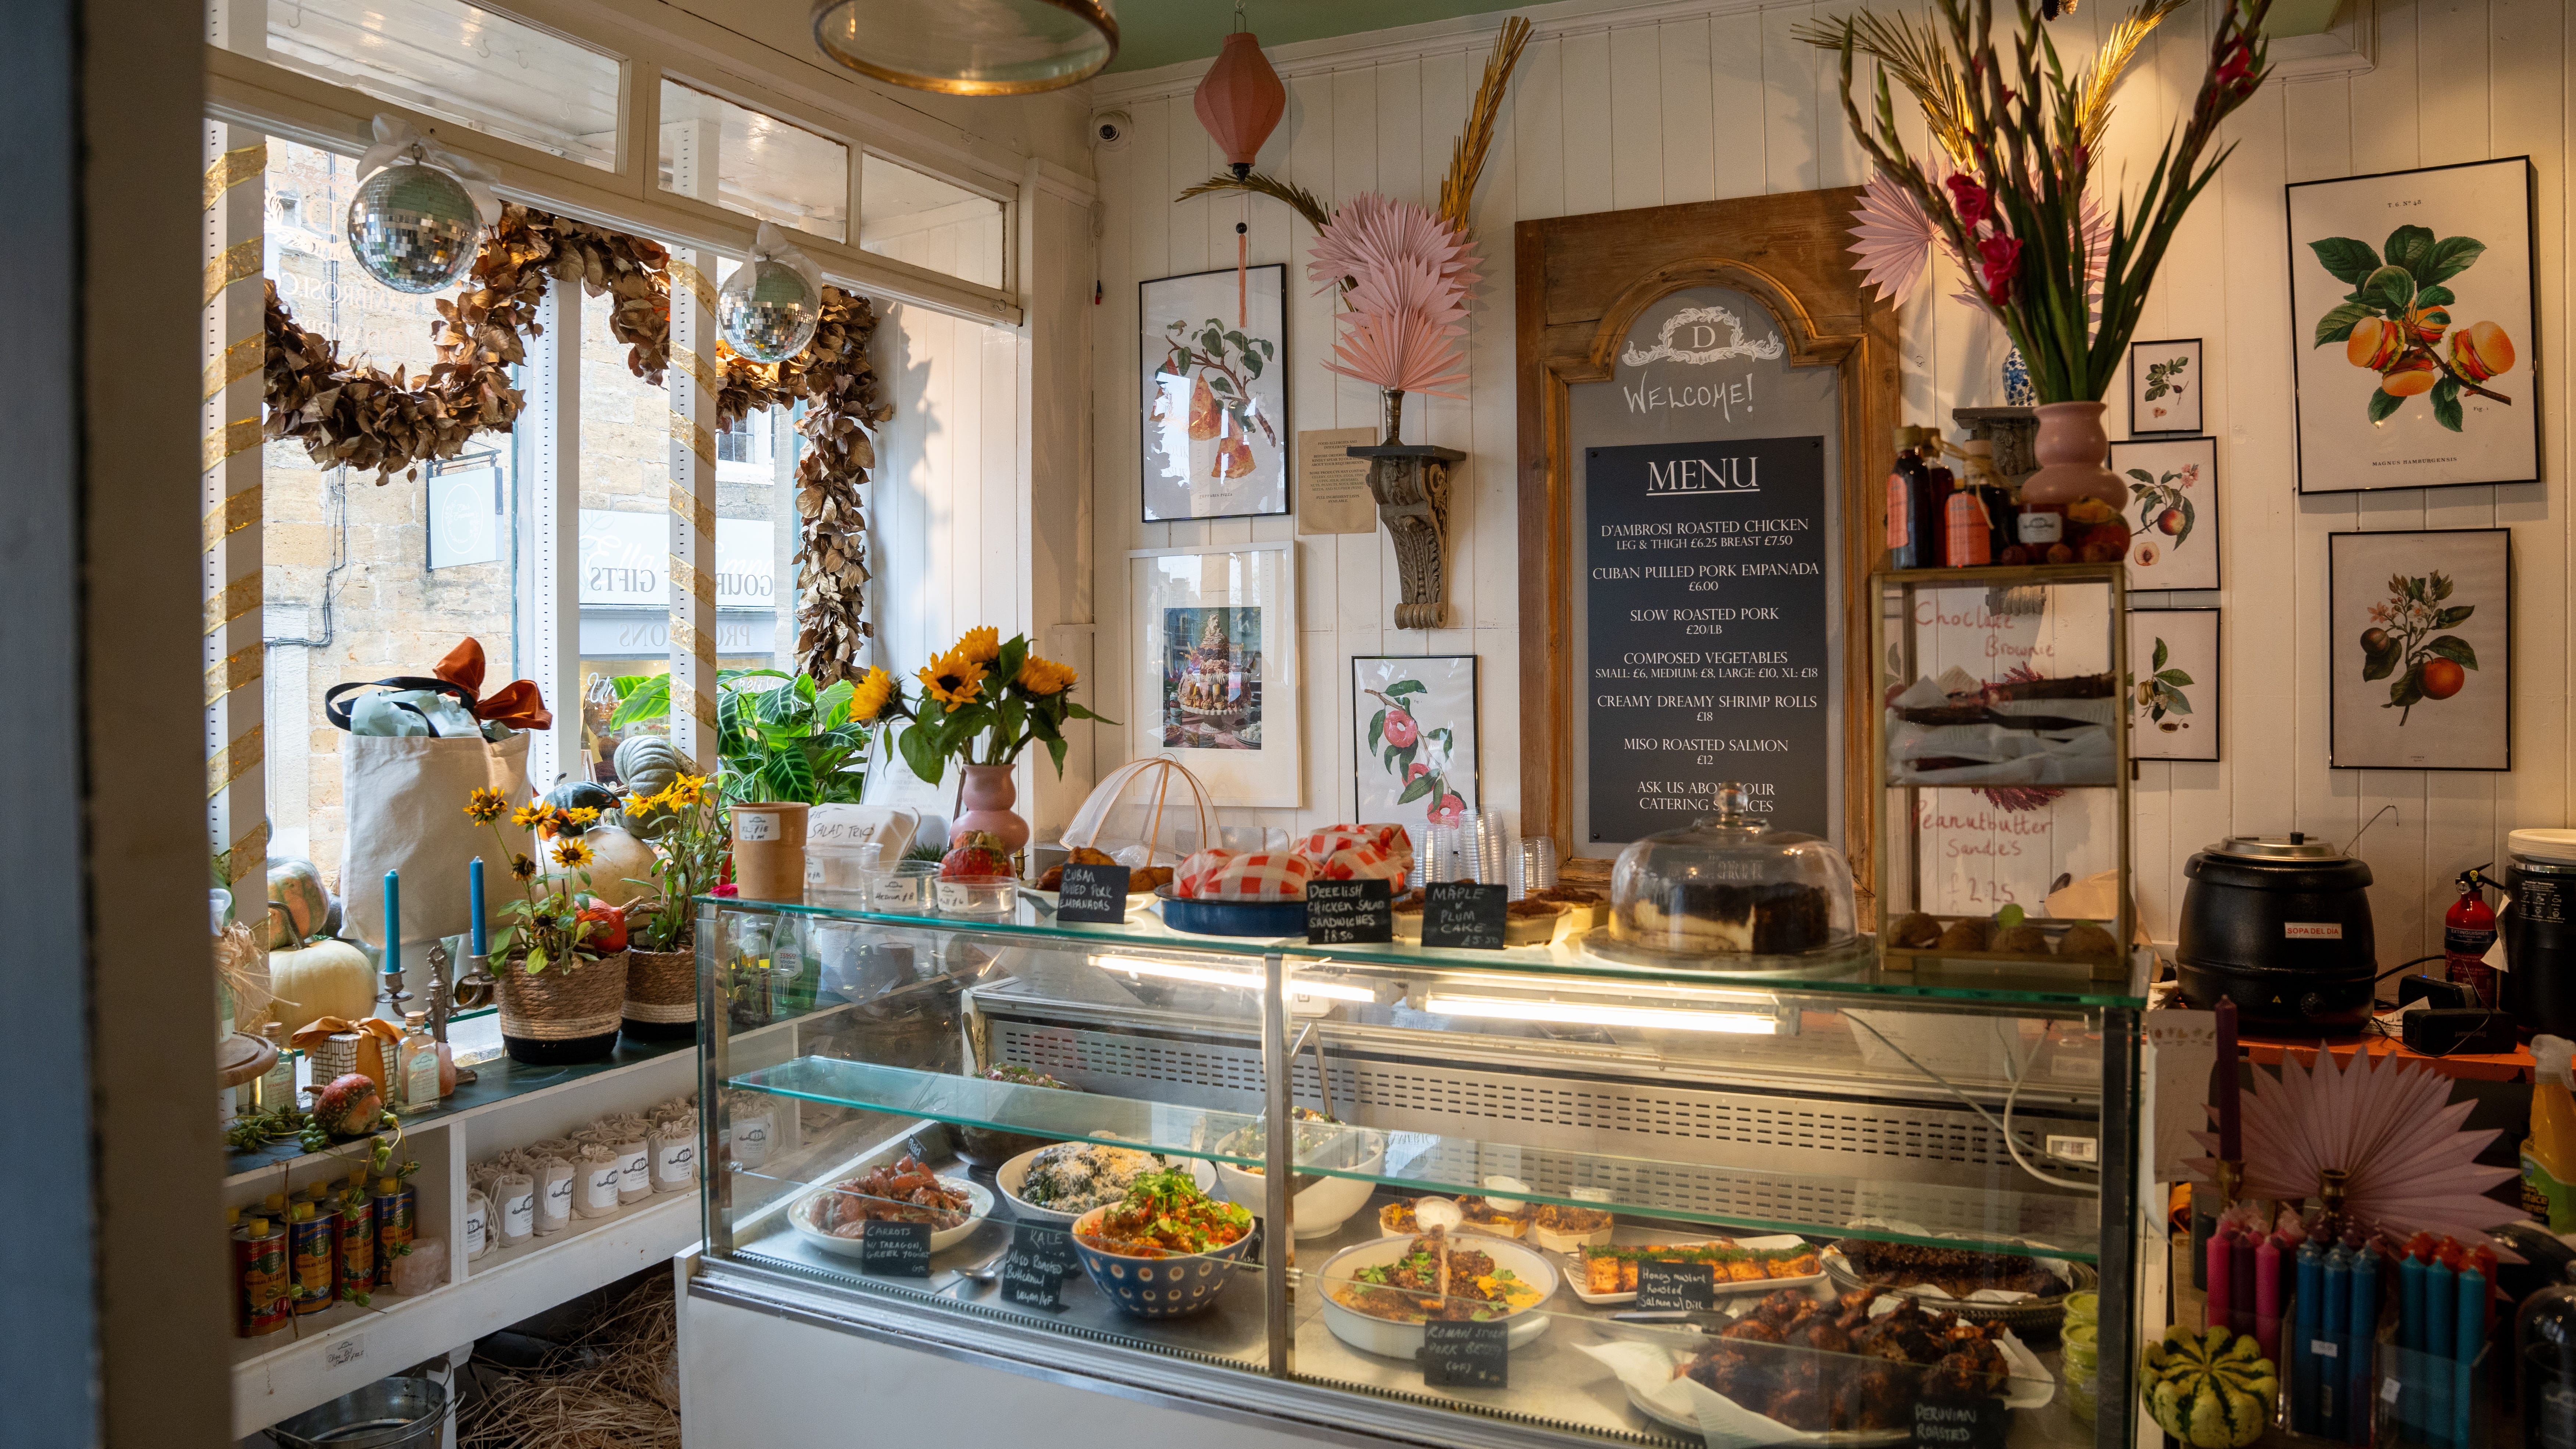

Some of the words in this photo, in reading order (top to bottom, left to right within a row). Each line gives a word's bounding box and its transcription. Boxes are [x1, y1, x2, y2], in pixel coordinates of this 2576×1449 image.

[1692, 326, 1715, 348] D
[1623, 371, 1753, 422] WELCOME!
[1647, 457, 1759, 491] MENU
[1601, 523, 1672, 537] D'AMBROSI
[1677, 521, 1739, 534] ROASTED
[1745, 519, 1809, 532] CHICKEN
[1617, 539, 1636, 550] LEG
[1639, 539, 1647, 549] &
[1650, 538, 1688, 549] THIGH
[1690, 537, 1717, 548] £6.25
[1721, 536, 1761, 547] BREAST
[1764, 535, 1793, 546] £7.50
[1593, 566, 1640, 580] CUBAN
[1645, 565, 1695, 579] PULLED
[1699, 564, 1737, 577] PORK
[1742, 562, 1820, 576] EMPANADA
[1688, 581, 1719, 591] £6.00
[1630, 609, 1668, 622] SLOW
[1673, 608, 1736, 621] ROASTED
[1740, 607, 1779, 620] PORK
[1686, 625, 1723, 635] £20/LB
[1624, 652, 1700, 665] COMPOSED
[1706, 651, 1788, 664] VEGETABLES
[1595, 668, 1631, 679] SMALL:
[1633, 668, 1649, 680] £6,
[1651, 668, 1699, 679] MEDIUM:
[1700, 668, 1716, 679] £8,
[1718, 668, 1756, 679] LARGE:
[1759, 668, 1779, 679] £10,
[1781, 668, 1799, 678] XL:
[1801, 668, 1818, 678] £18
[1597, 695, 1652, 708] CREAMY
[1657, 695, 1715, 708] DREAMY
[1718, 695, 1770, 708] SHRIMP
[1775, 696, 1818, 708] ROLLS
[1697, 711, 1713, 722] £18
[1624, 738, 1658, 751] MISO
[1662, 738, 1725, 751] ROASTED
[1729, 739, 1789, 752] SALMON
[1697, 755, 1714, 765] £12
[1637, 781, 1661, 794] ASK
[1667, 781, 1684, 794] US
[1689, 782, 1721, 794] ABO
[1639, 798, 1709, 811] CATERING
[811, 823, 844, 839] SALAD
[848, 826, 874, 839] TRIO
[1064, 868, 1095, 883] CUBAN
[1441, 910, 1475, 924] PLUM
[1440, 923, 1484, 934] CAKE
[1030, 1229, 1063, 1249] KALE
[1642, 1268, 1671, 1284] Honey
[1640, 1295, 1671, 1308] Salmon
[1914, 1402, 1977, 1423] PERUVIAN
